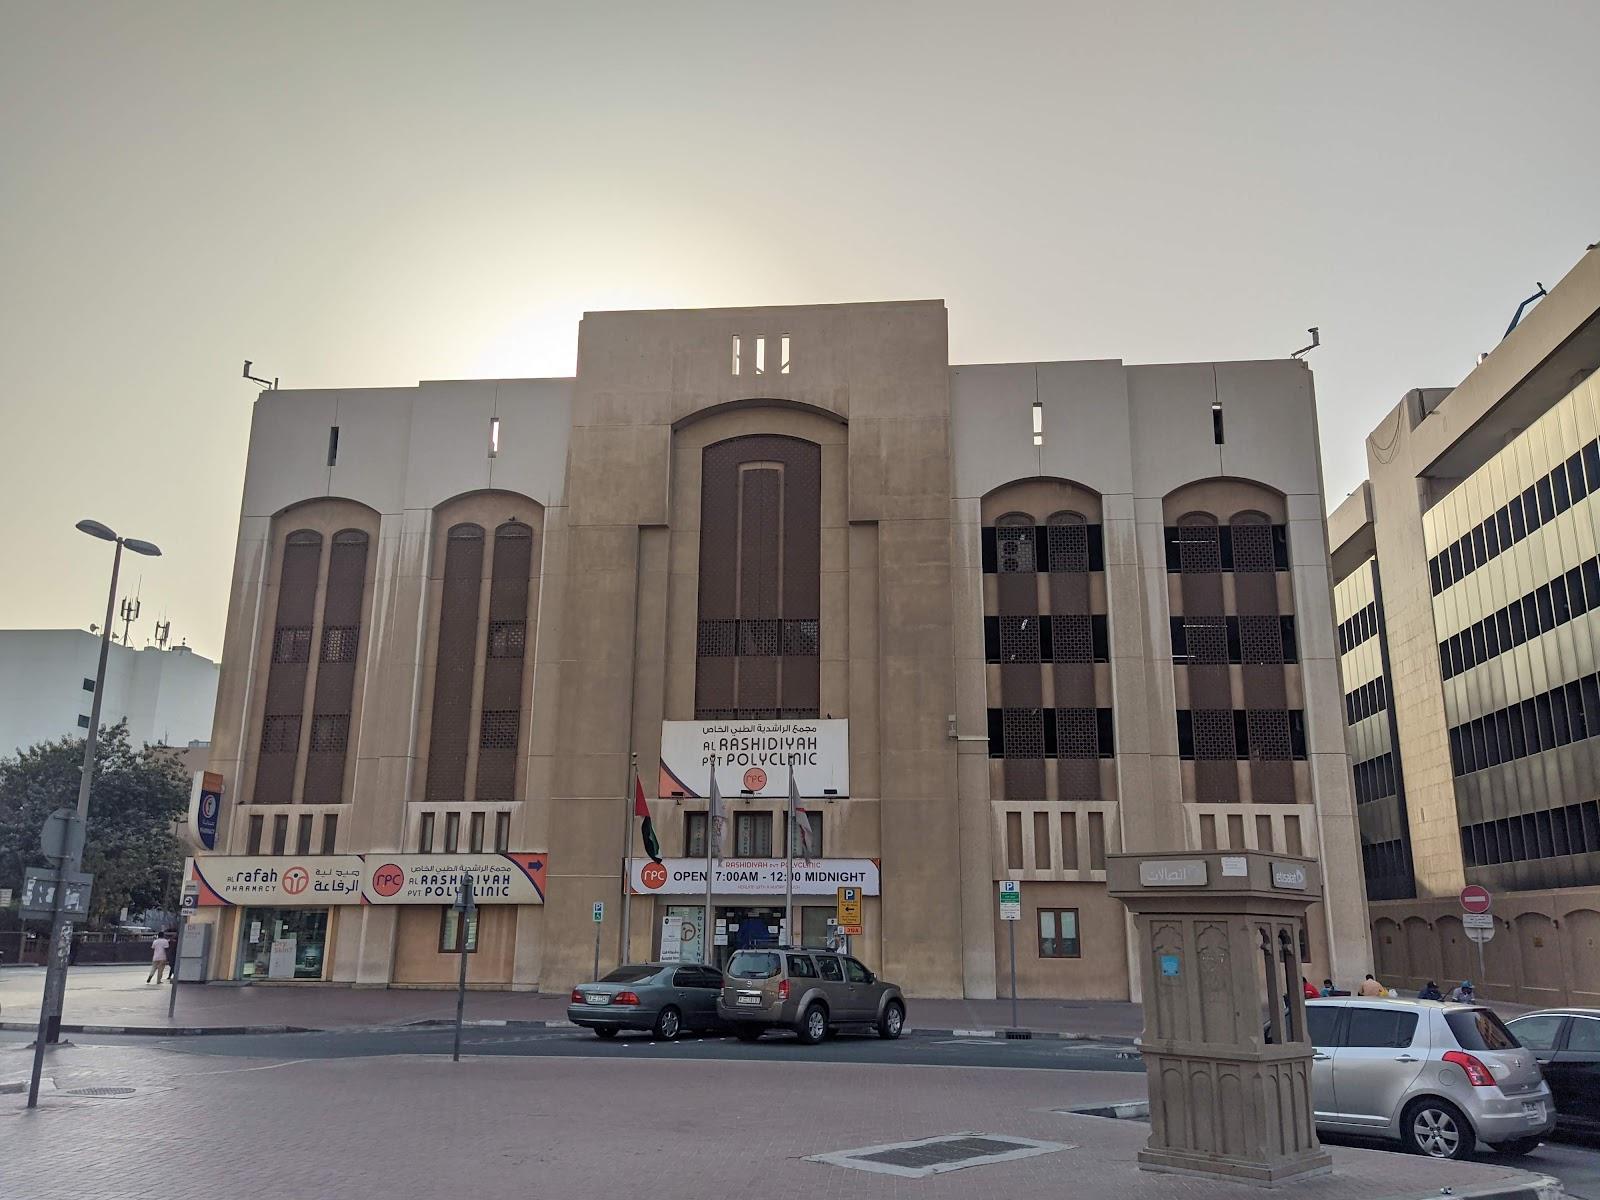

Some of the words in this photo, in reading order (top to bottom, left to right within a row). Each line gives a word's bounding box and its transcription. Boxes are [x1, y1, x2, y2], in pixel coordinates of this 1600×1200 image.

[702, 725, 729, 735] الخاص
[730, 724, 756, 736] الطبي
[757, 724, 791, 734] الراشدية
[792, 724, 817, 734] مجمع
[703, 741, 717, 751] AL
[719, 737, 817, 751] RASHIDIYAH
[410, 865, 435, 873] الخاص
[435, 865, 458, 874] الطبي
[459, 864, 490, 873] الراشدية
[490, 865, 512, 873] مجمع
[236, 868, 278, 883] rafah
[673, 871, 709, 881] OPEN
[715, 871, 758, 882] 7:00AM
[805, 871, 866, 882] MIDNIGHT
[314, 879, 360, 895] الرفاعة
[407, 889, 421, 897] PVT
[424, 886, 510, 897] POLYLINIC
